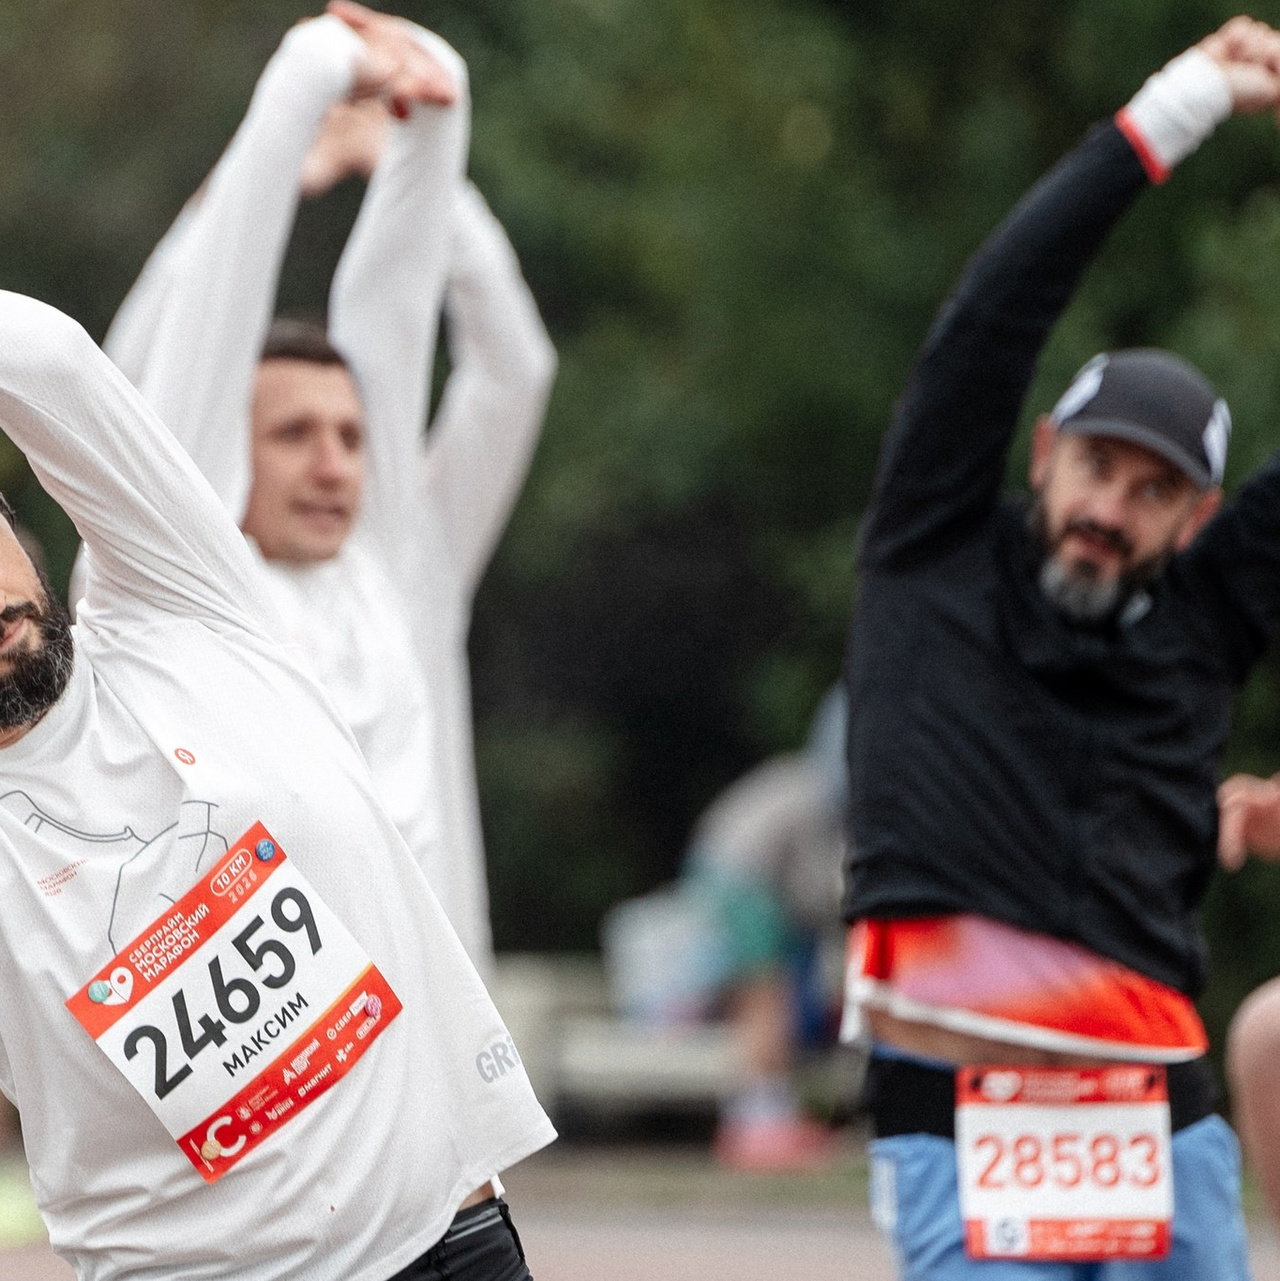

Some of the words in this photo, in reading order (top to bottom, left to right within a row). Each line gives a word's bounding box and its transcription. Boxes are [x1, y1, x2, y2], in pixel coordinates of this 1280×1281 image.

[216, 872, 230, 890] 10
[229, 854, 247, 877] КМ
[128, 912, 185, 963] СБЕРПРАЙМ
[135, 902, 210, 973] МОСКОВСКИЙ
[142, 929, 200, 983] МАРАФОН
[123, 885, 323, 1101] 24659
[222, 991, 310, 1077] МАКСИМ
[973, 1132, 1161, 1190] 28583
